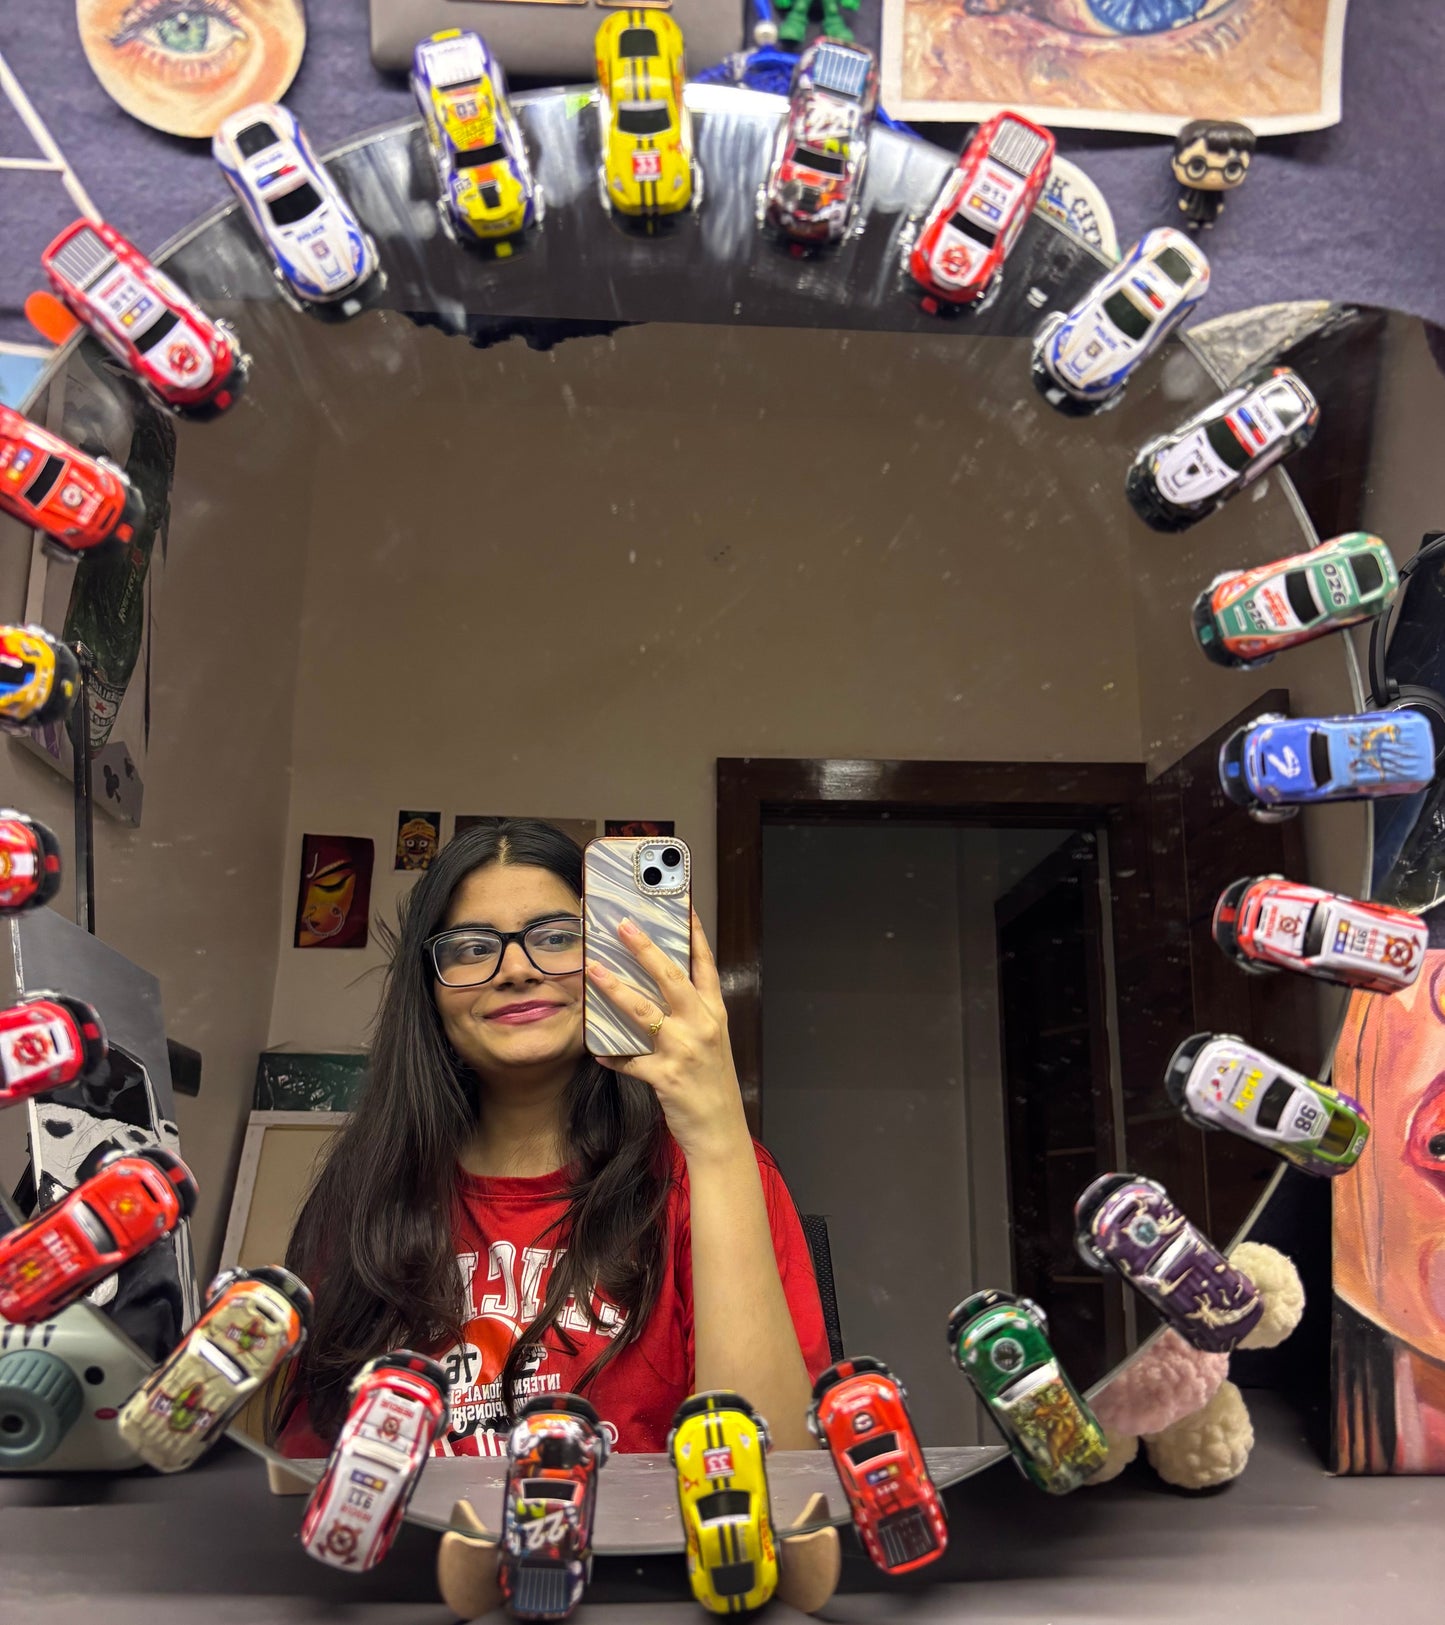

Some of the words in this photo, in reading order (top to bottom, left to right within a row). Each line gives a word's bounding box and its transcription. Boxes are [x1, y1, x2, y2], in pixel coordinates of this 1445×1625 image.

[635, 156, 660, 175] 33
[1322, 563, 1347, 606] 026
[1243, 600, 1268, 631] 026
[1354, 929, 1368, 953] 911
[1295, 1104, 1318, 1133] 98
[706, 1454, 732, 1472] 33
[348, 1488, 373, 1509] 911
[522, 1509, 567, 1551] 22
